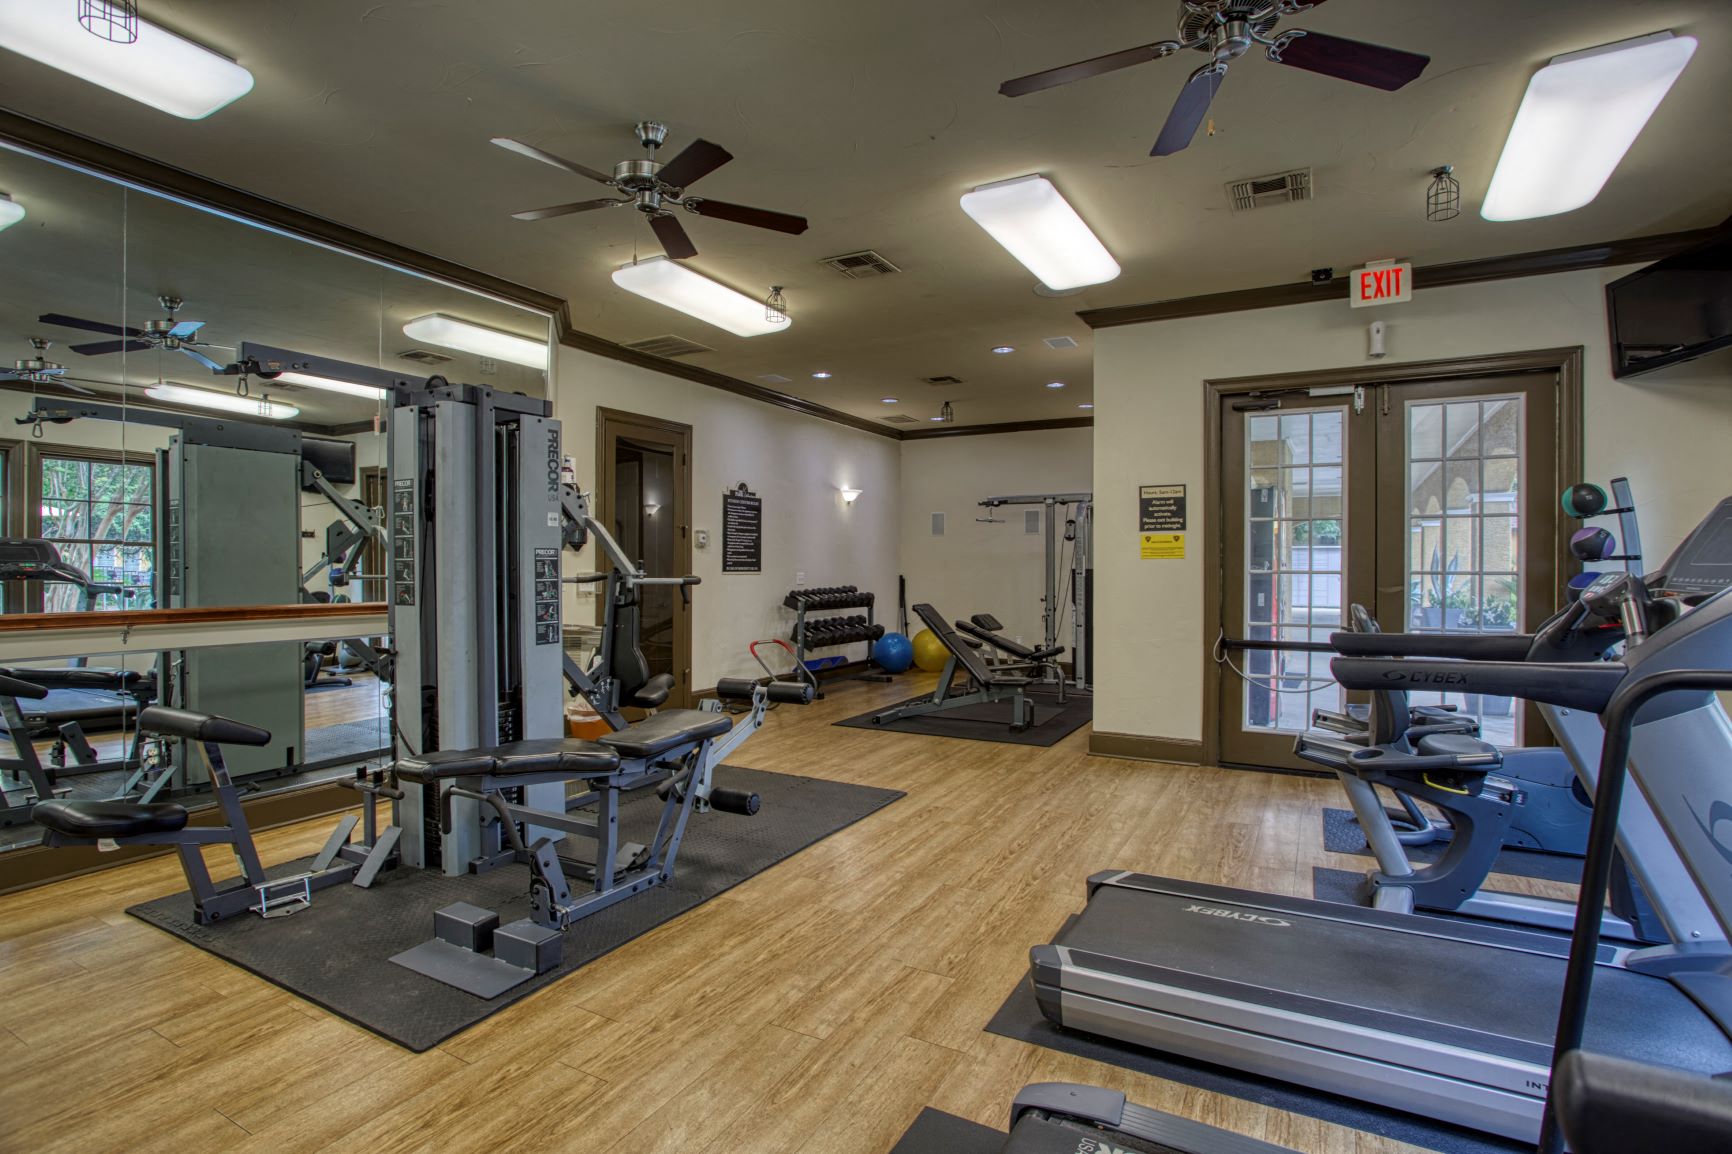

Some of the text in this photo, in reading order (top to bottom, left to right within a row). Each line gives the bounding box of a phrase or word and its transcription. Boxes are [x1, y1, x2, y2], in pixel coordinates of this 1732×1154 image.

[1361, 267, 1403, 300] EXIT
[547, 428, 559, 492] PRECOR
[1409, 671, 1470, 684] CYBEX
[1185, 904, 1258, 922] CYBEX
